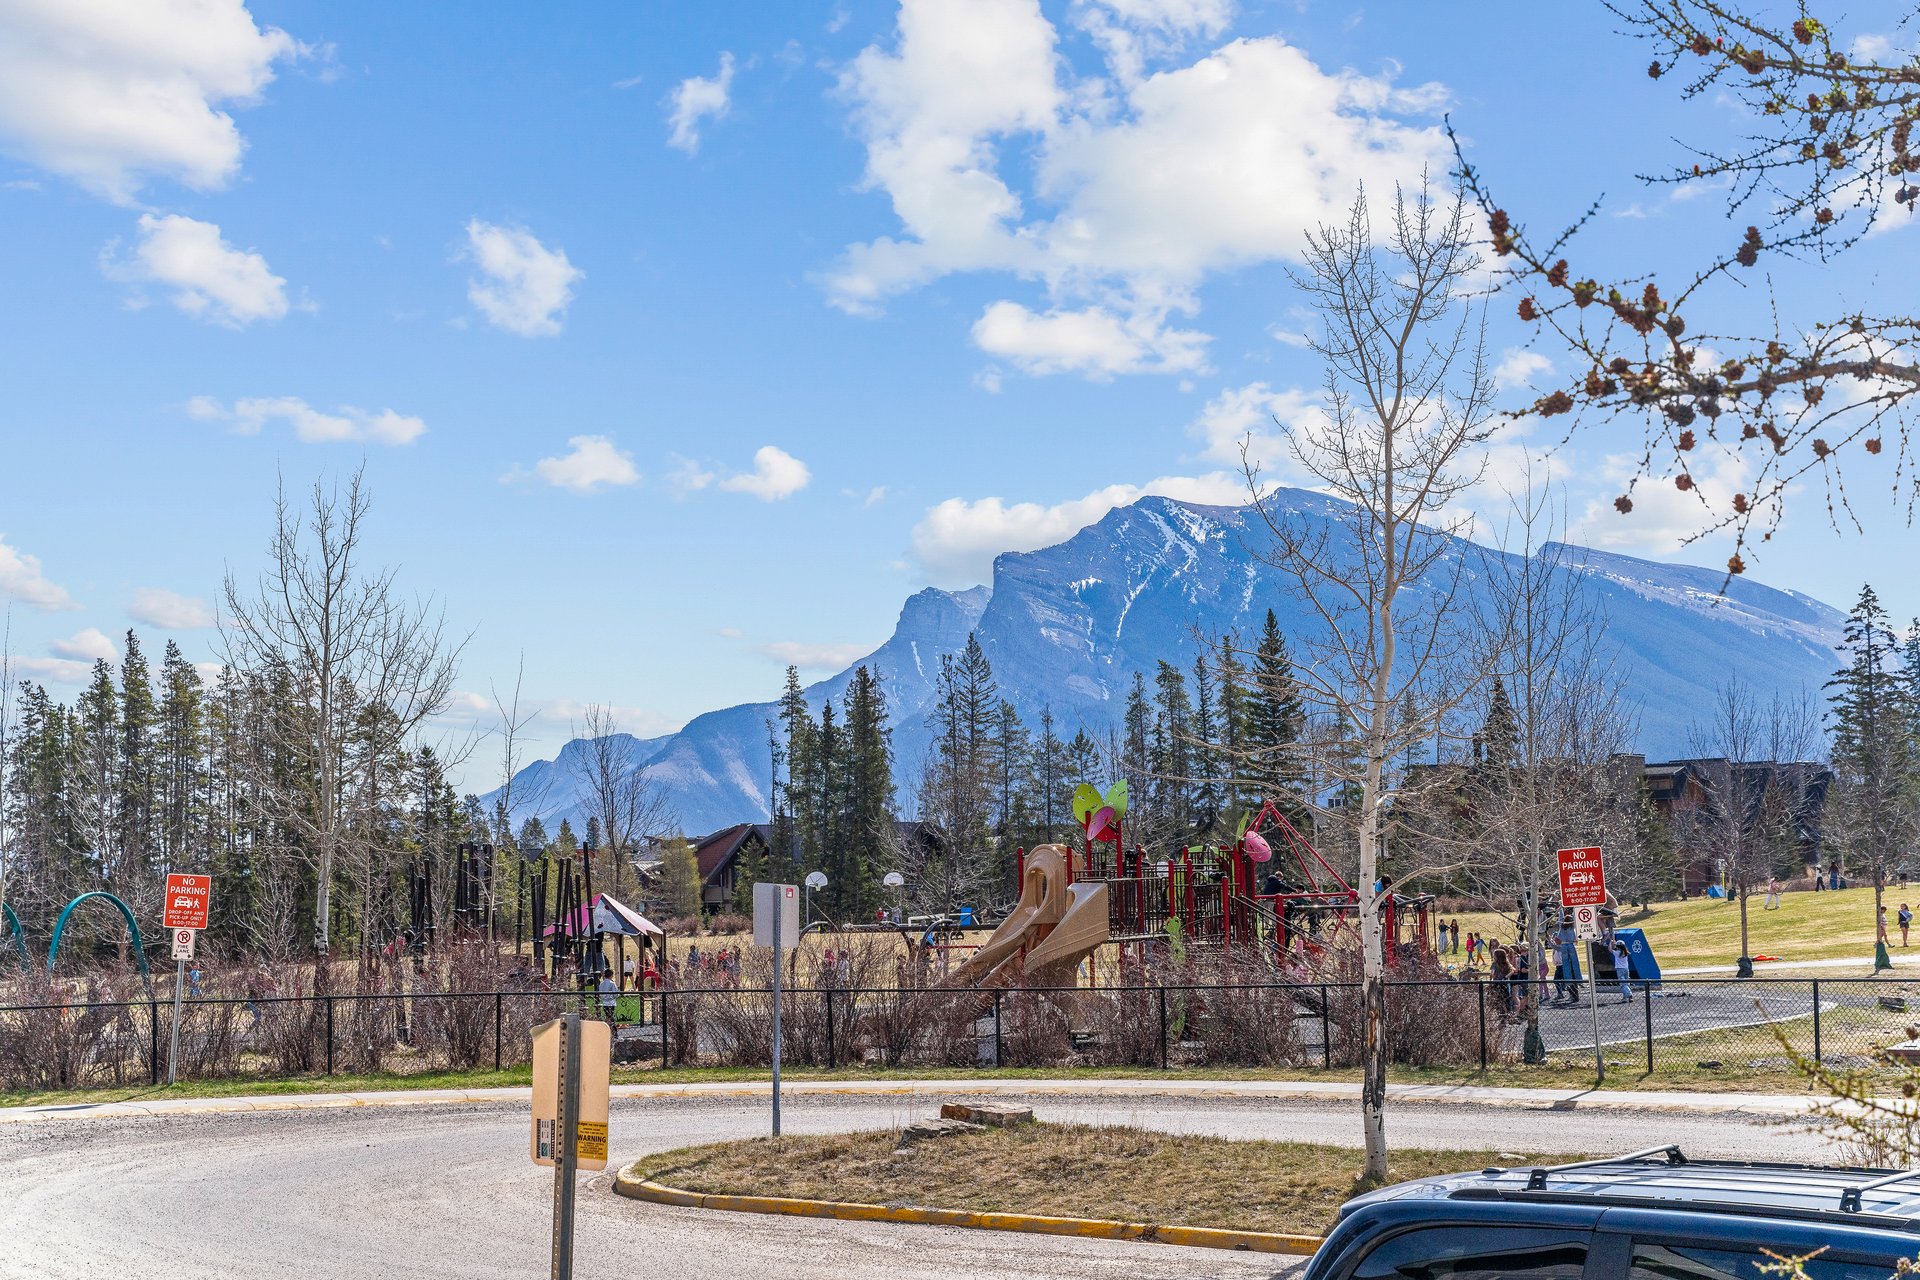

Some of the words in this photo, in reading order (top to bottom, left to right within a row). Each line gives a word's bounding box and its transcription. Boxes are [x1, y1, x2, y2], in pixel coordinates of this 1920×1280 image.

[1573, 851, 1586, 860] NO
[1562, 860, 1599, 870] PARKING
[170, 886, 206, 895] PARKING
[577, 1134, 606, 1143] WARNING
